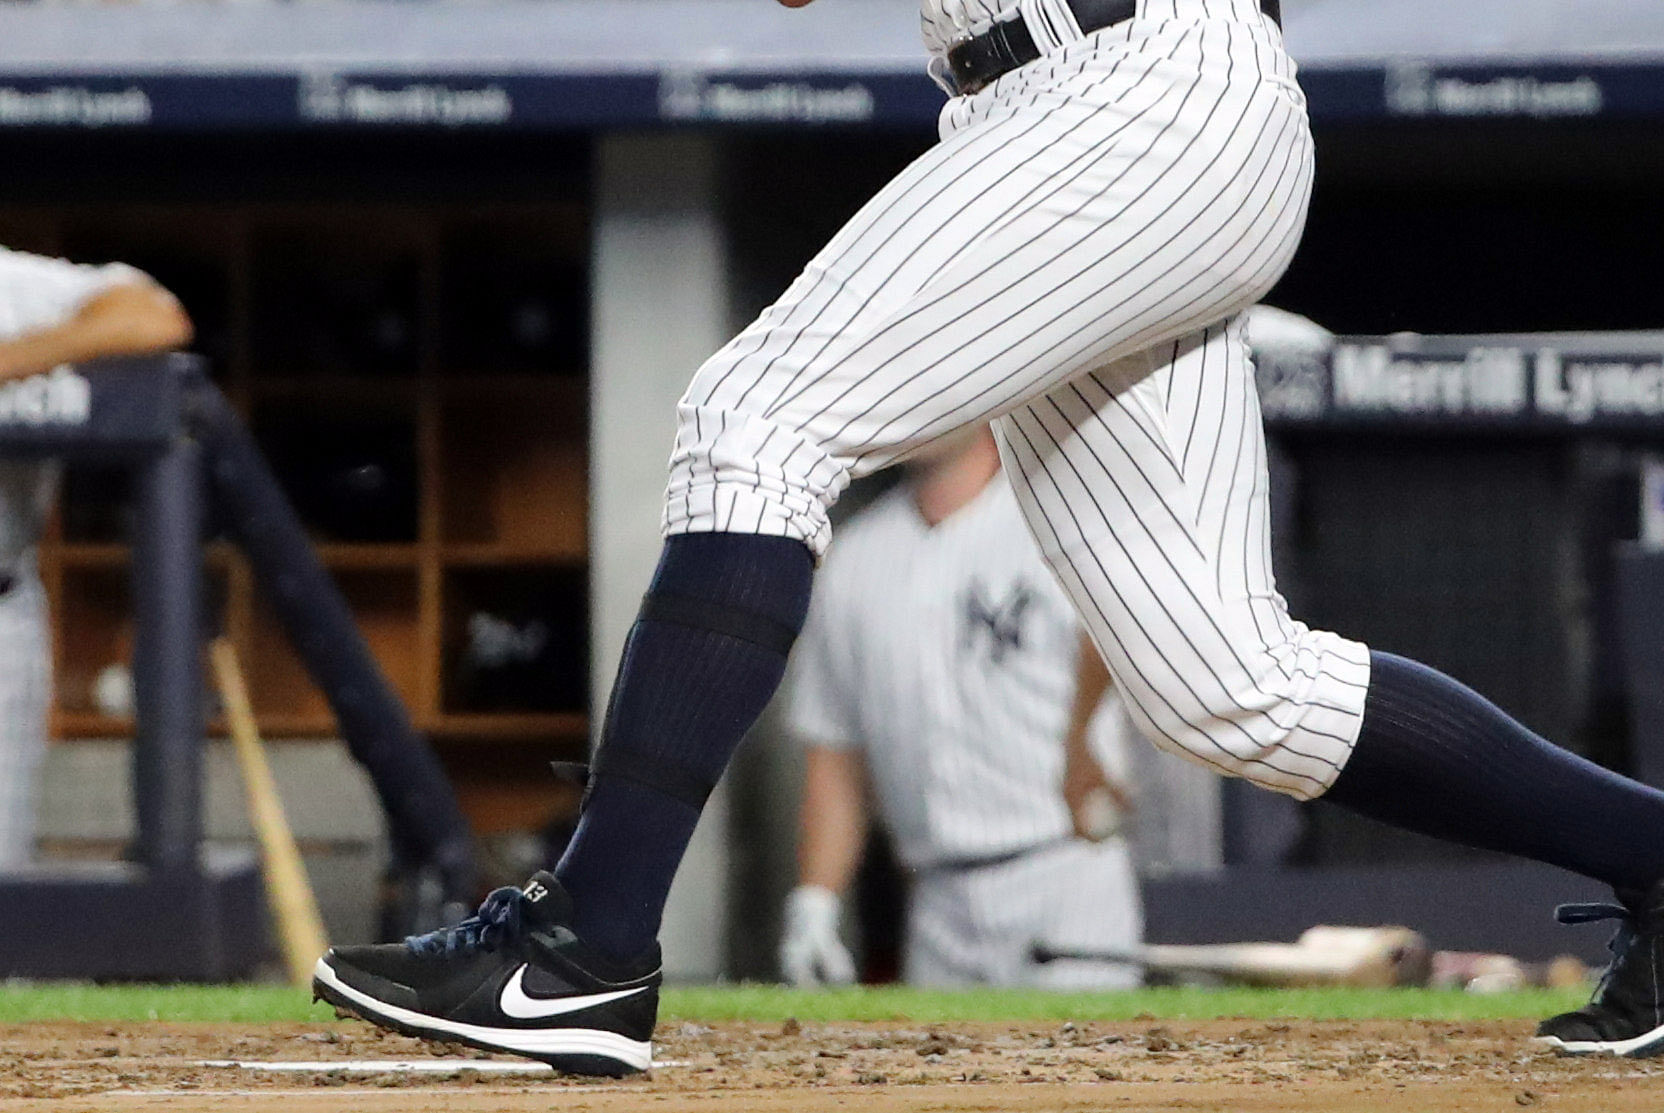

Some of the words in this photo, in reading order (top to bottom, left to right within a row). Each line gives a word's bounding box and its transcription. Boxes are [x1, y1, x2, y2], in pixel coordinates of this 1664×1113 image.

[1333, 345, 1525, 415] Merrill
[956, 574, 1033, 658] NY
[523, 880, 549, 903] 13
